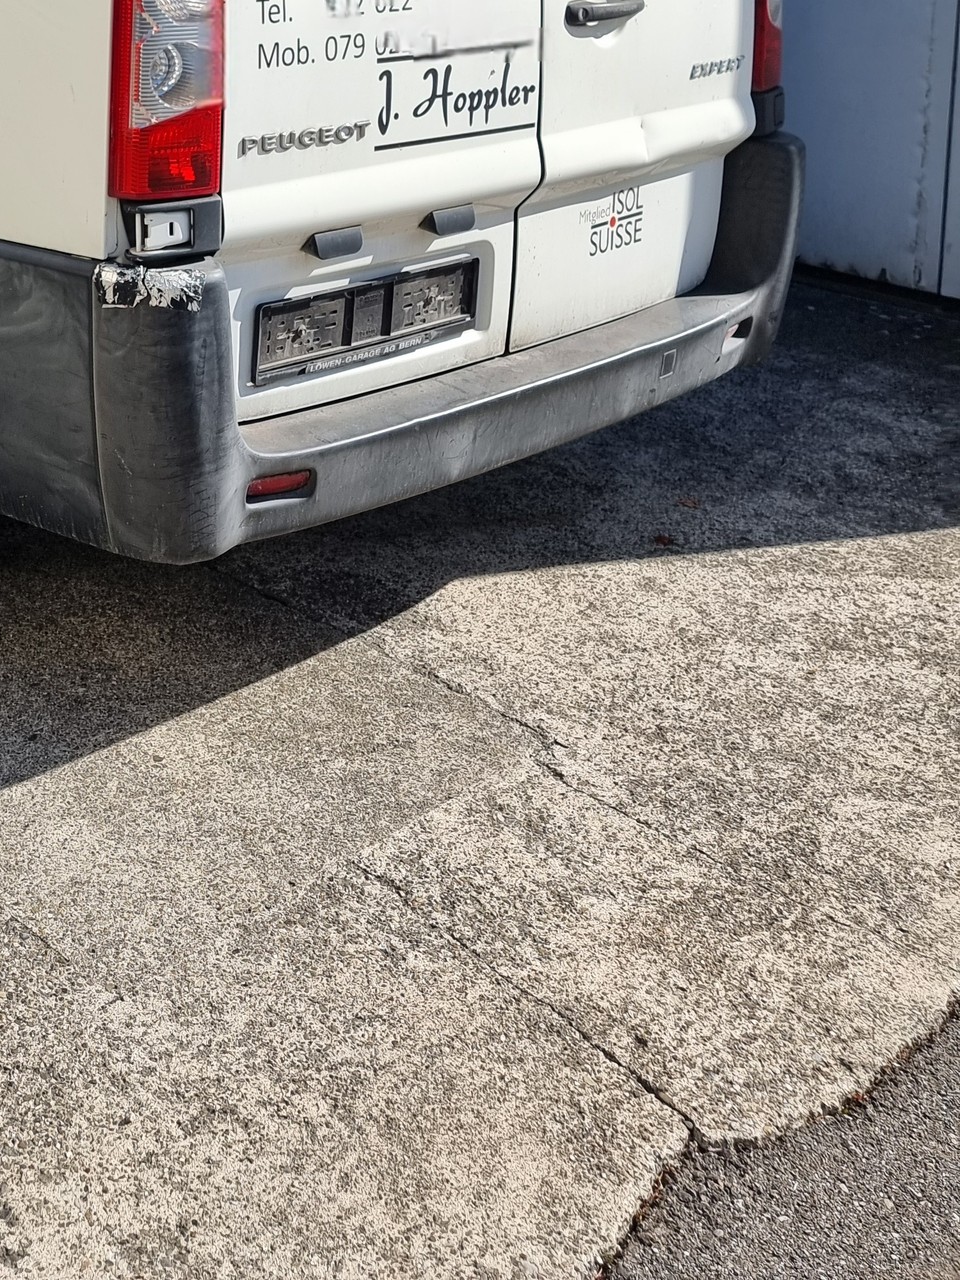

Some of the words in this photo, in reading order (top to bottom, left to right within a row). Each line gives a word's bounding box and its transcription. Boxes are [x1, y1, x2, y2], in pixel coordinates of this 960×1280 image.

[258, 38, 315, 69] Mob.
[325, 33, 365, 61] 079
[689, 54, 745, 80] EXPERT
[377, 70, 399, 136] J.
[412, 52, 536, 127] Hoppler
[237, 120, 371, 159] PEUGEOT
[579, 202, 611, 224] Mitglied
[612, 185, 643, 214] ISOL
[383, 344, 396, 355] AG
[399, 337, 422, 350] BERN
